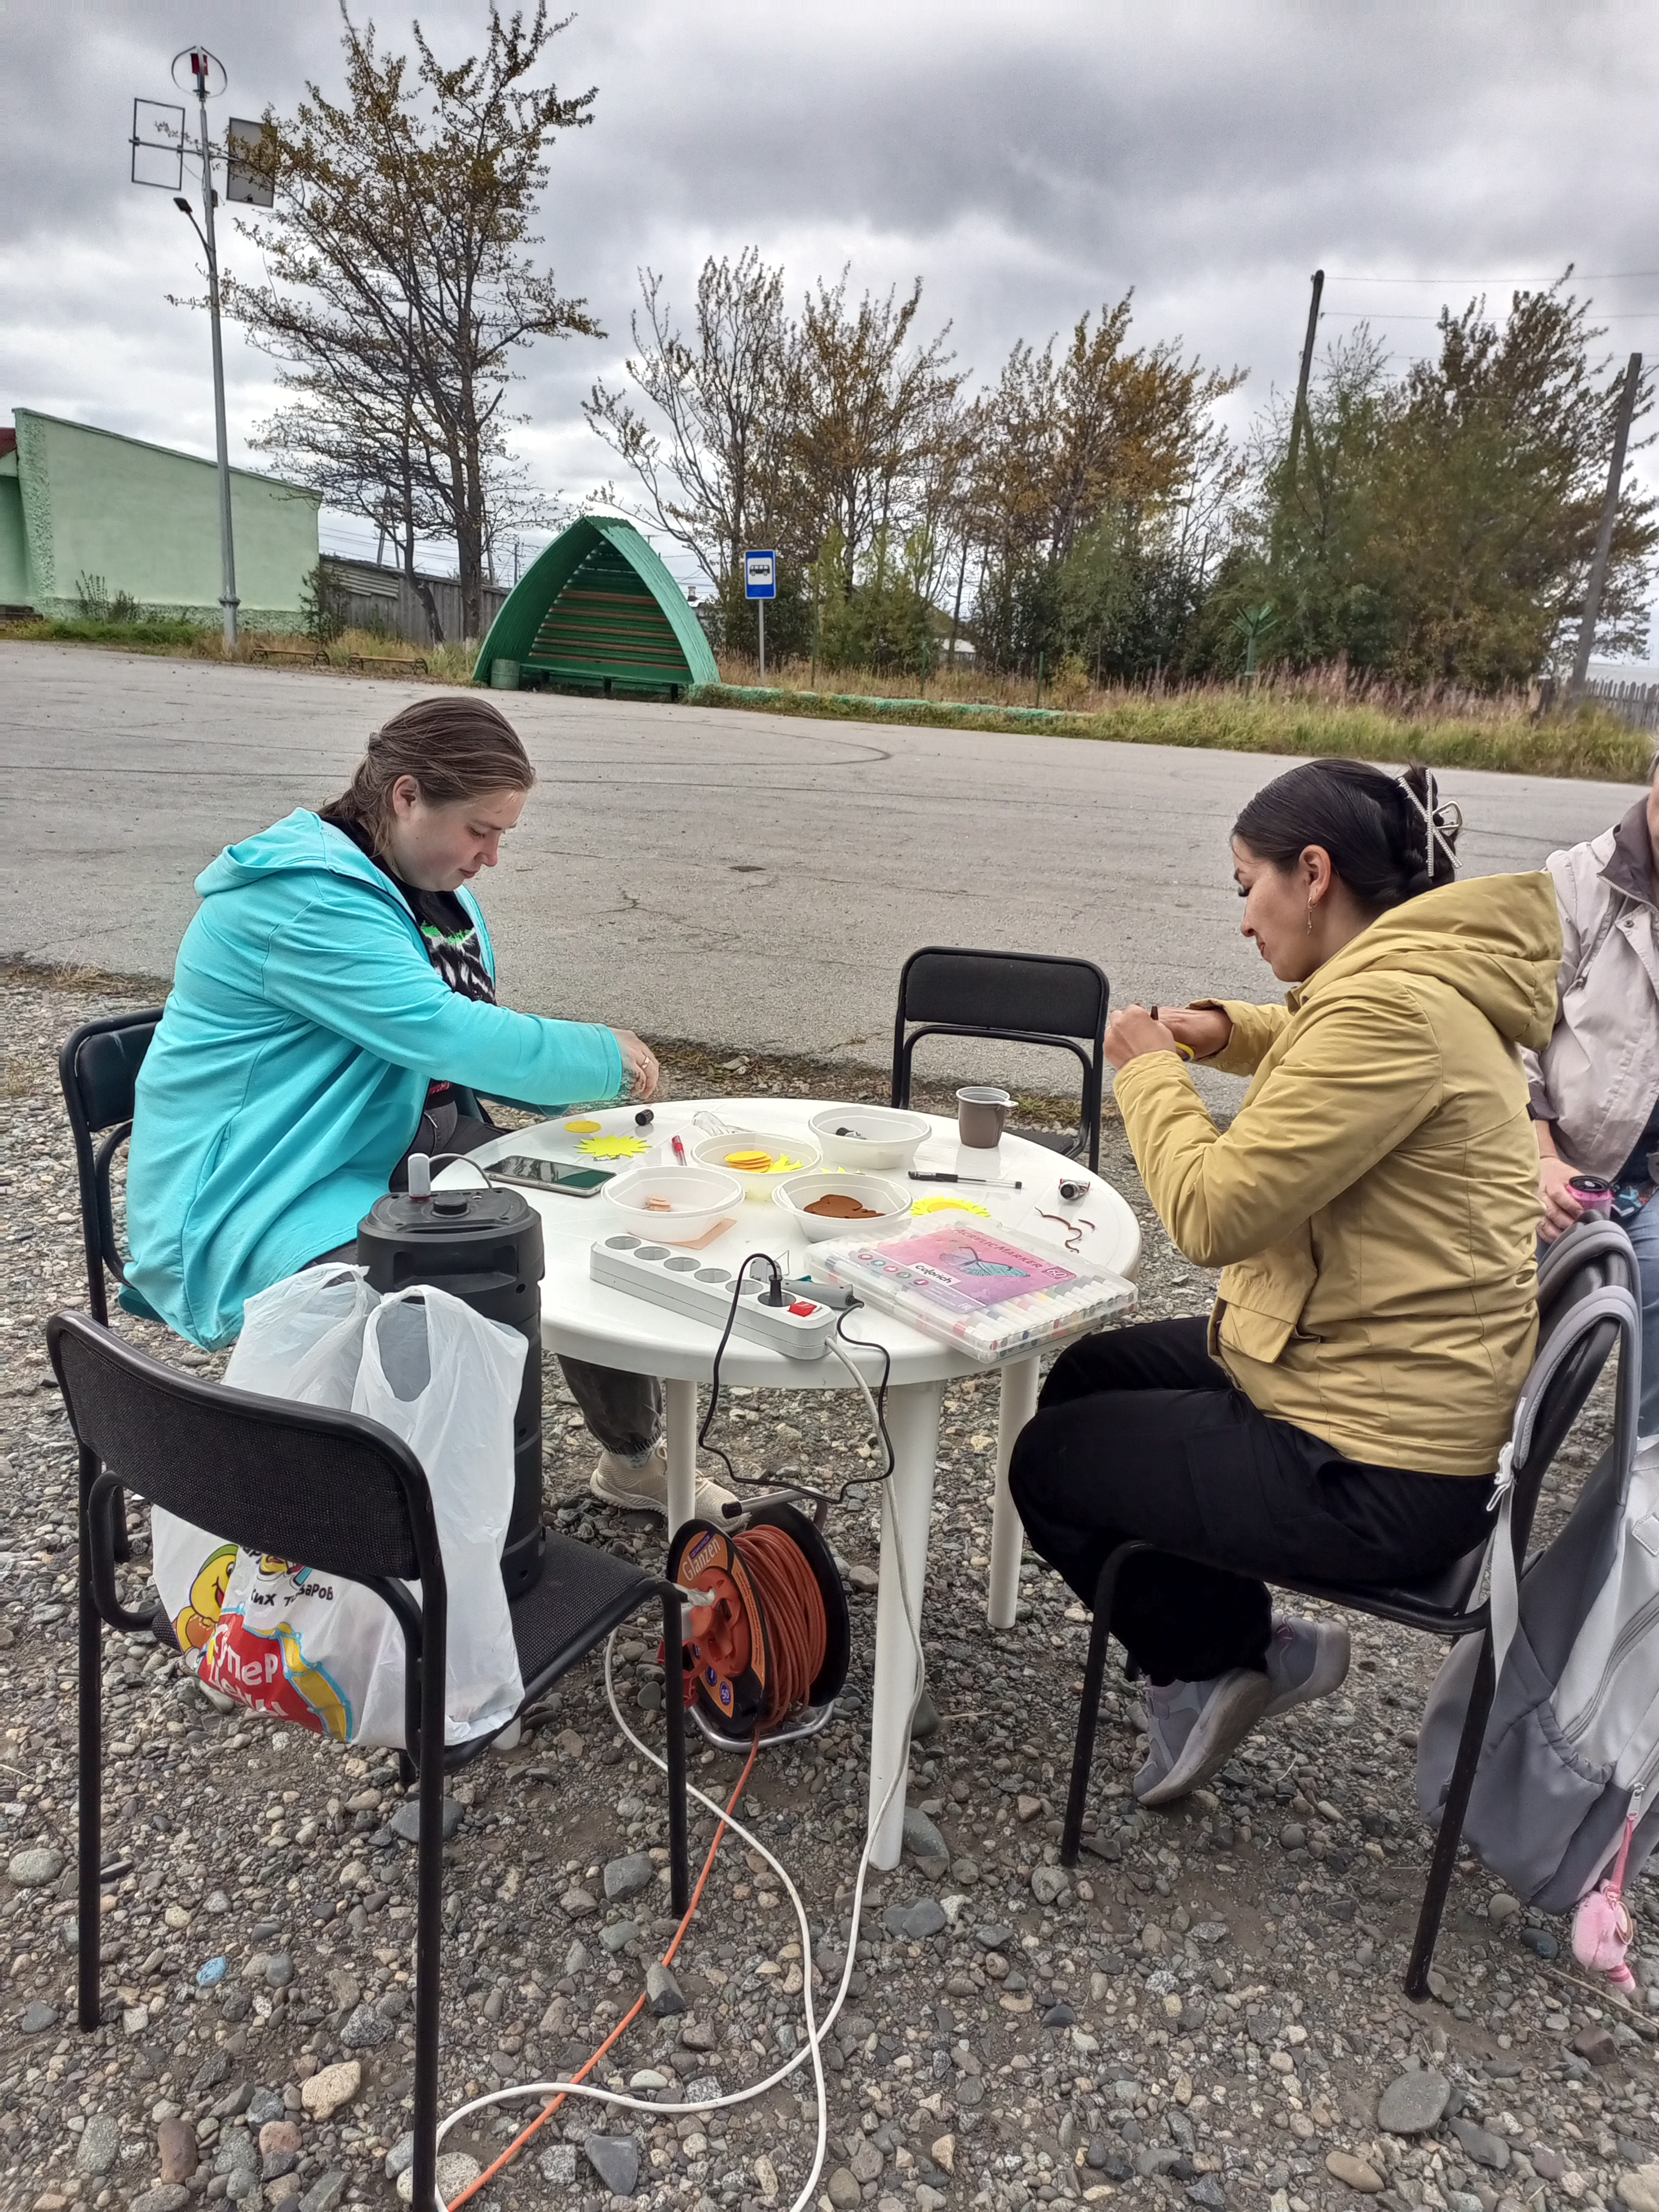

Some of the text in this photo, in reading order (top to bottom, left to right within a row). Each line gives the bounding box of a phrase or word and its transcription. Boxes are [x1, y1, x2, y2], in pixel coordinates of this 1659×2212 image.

[1046, 1269, 1068, 1278] 60
[682, 1537, 721, 1582] Glanzen
[722, 1689, 730, 1699] 50
